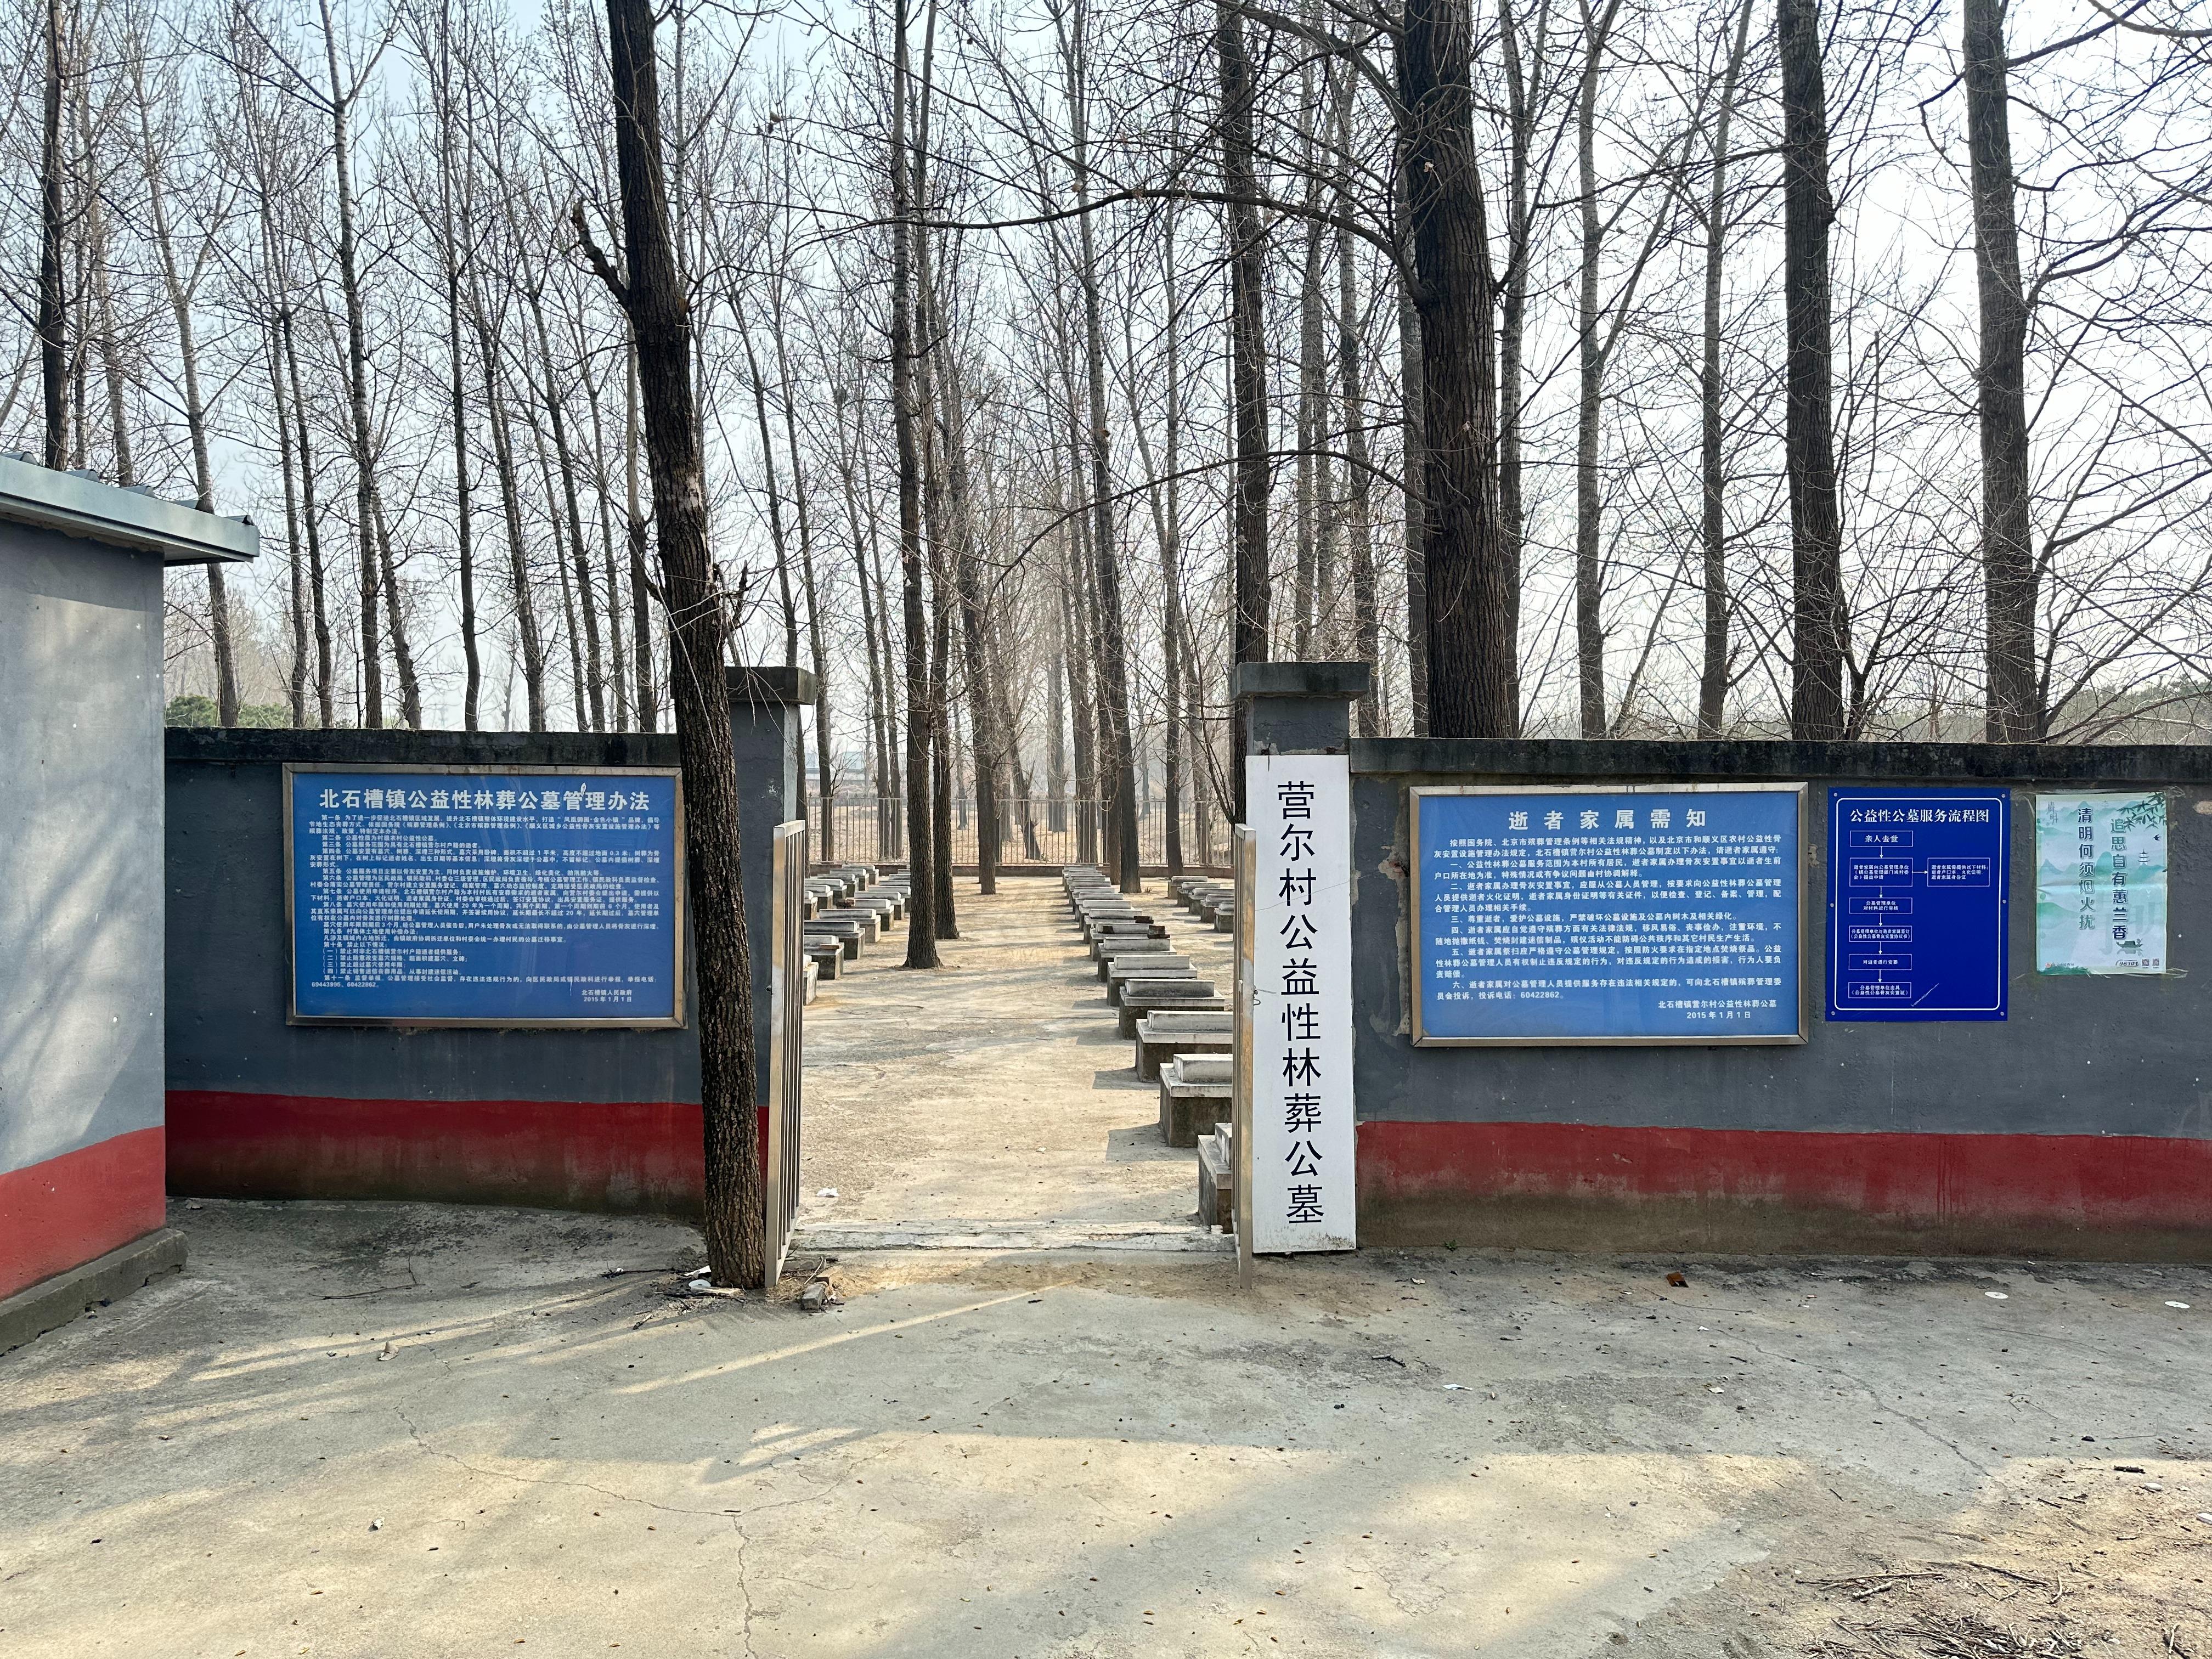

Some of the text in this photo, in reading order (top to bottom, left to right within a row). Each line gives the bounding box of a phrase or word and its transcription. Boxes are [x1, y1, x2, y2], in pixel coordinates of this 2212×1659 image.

[319, 789, 650, 811] 北石槽镇公益性林葬公墓管理办法
[1508, 809, 1707, 831] 逝者家属需知
[1849, 809, 1989, 823] 公益性公墓服务流程图
[2078, 808, 2095, 930] 清明何须烟火扰
[2111, 817, 2128, 940] 追思自有蕙兰香
[1435, 903, 1531, 912] 合管理人员办理相关手续。
[1277, 781, 1324, 1224] 营尔村公益性林葬公墓
[1658, 1000, 1776, 1008] 北石槽镇营尔村公益性林葬公墓
